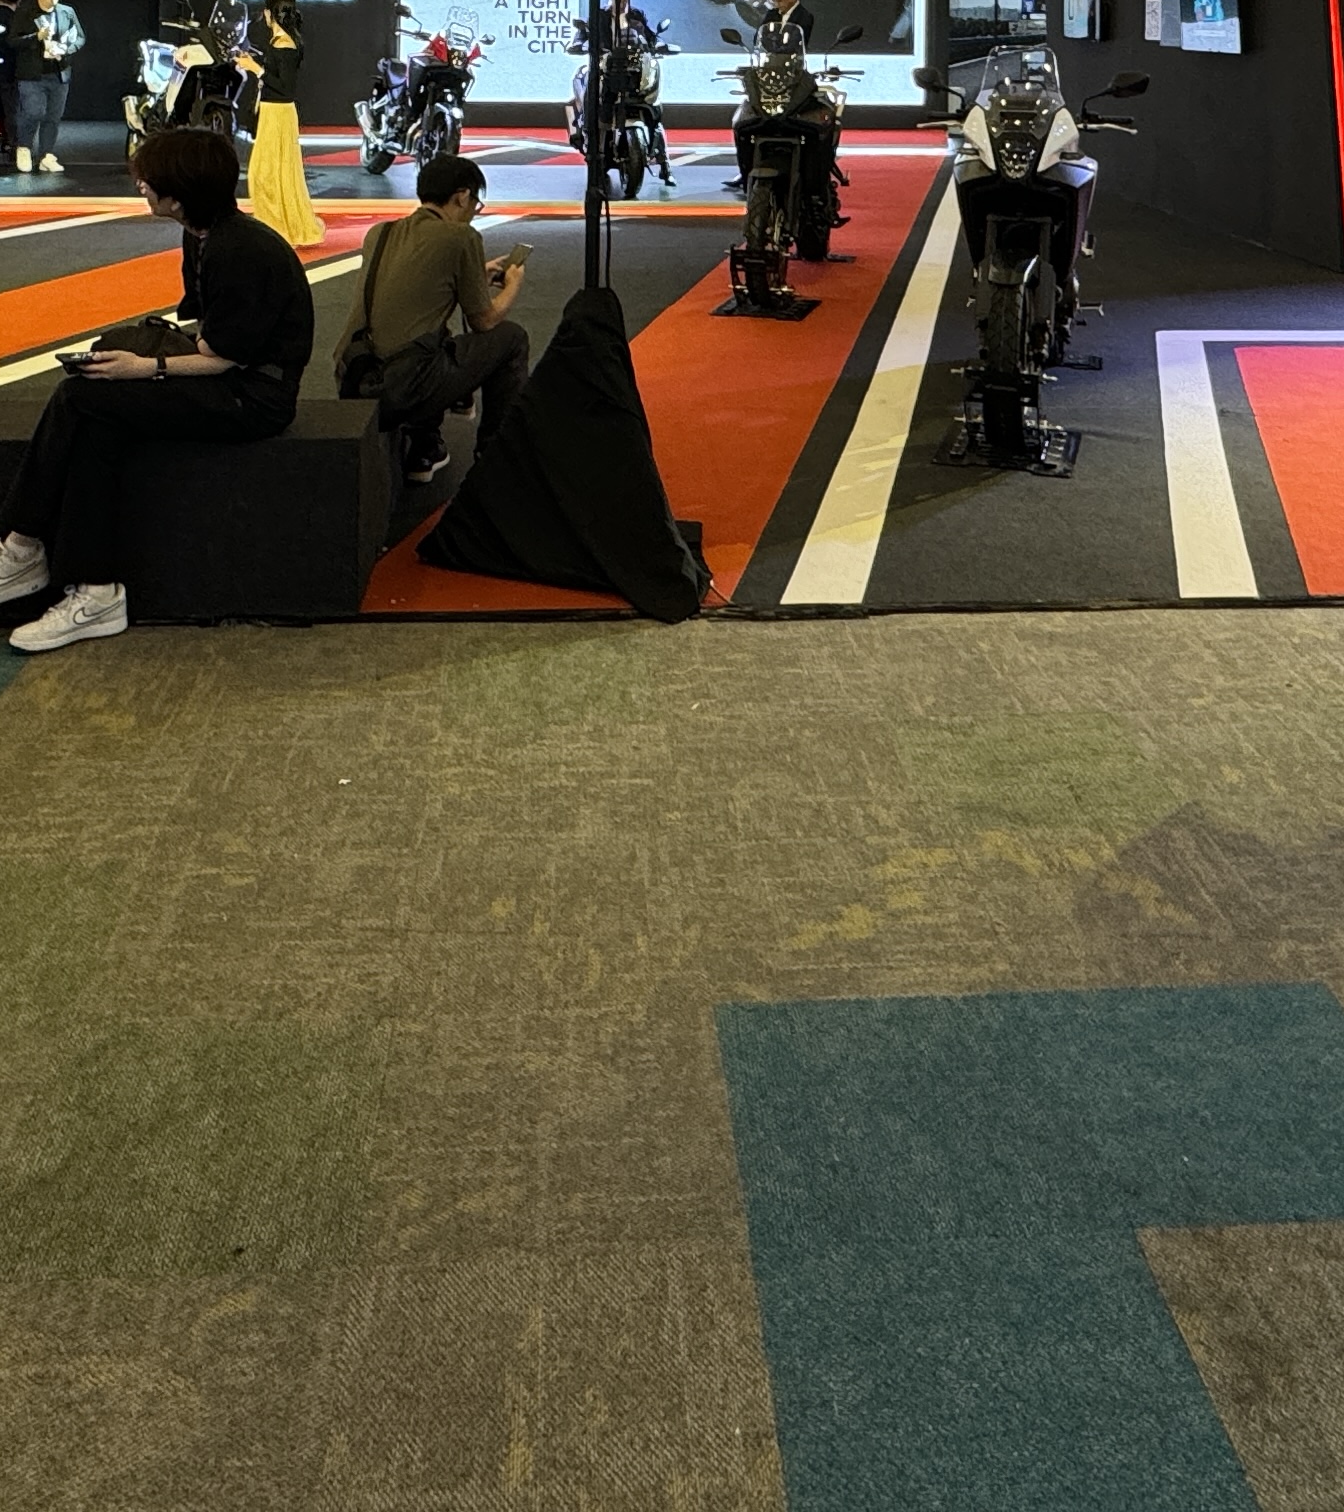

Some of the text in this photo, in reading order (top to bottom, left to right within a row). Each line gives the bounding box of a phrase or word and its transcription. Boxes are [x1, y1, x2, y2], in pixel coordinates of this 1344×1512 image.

[518, 11, 571, 24] TURN
[508, 25, 572, 39] IN THE
[527, 40, 571, 54] CITY
